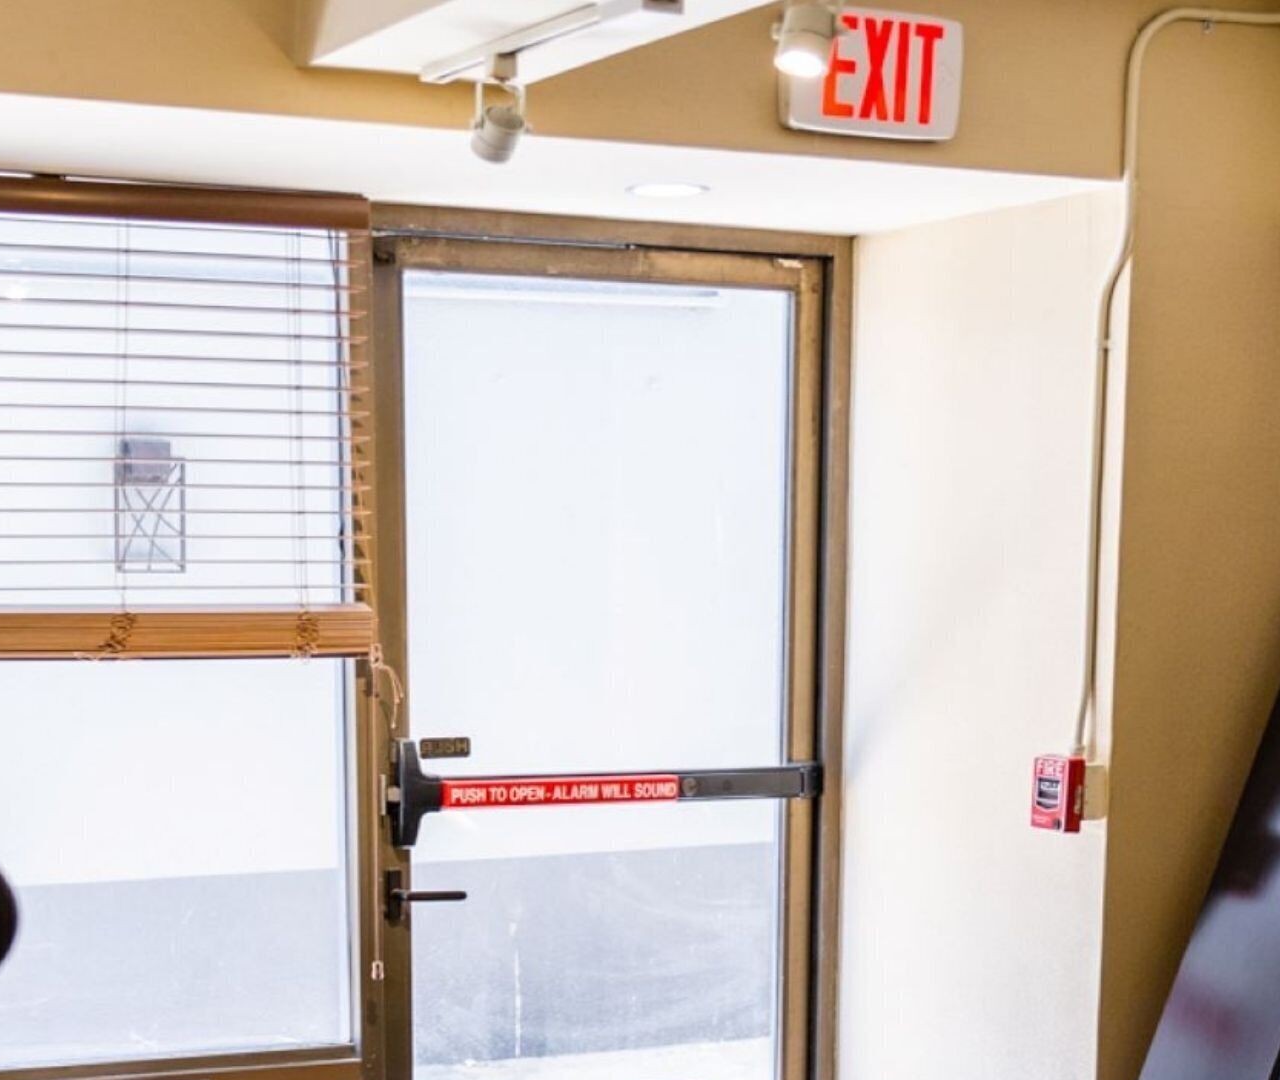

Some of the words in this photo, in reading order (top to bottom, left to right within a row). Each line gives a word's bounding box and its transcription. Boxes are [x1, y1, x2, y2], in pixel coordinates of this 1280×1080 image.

[822, 14, 944, 125] EXIT
[451, 787, 487, 804] PUSH
[488, 785, 508, 802] TO
[601, 782, 631, 799] WILL
[634, 781, 677, 799] SOUND
